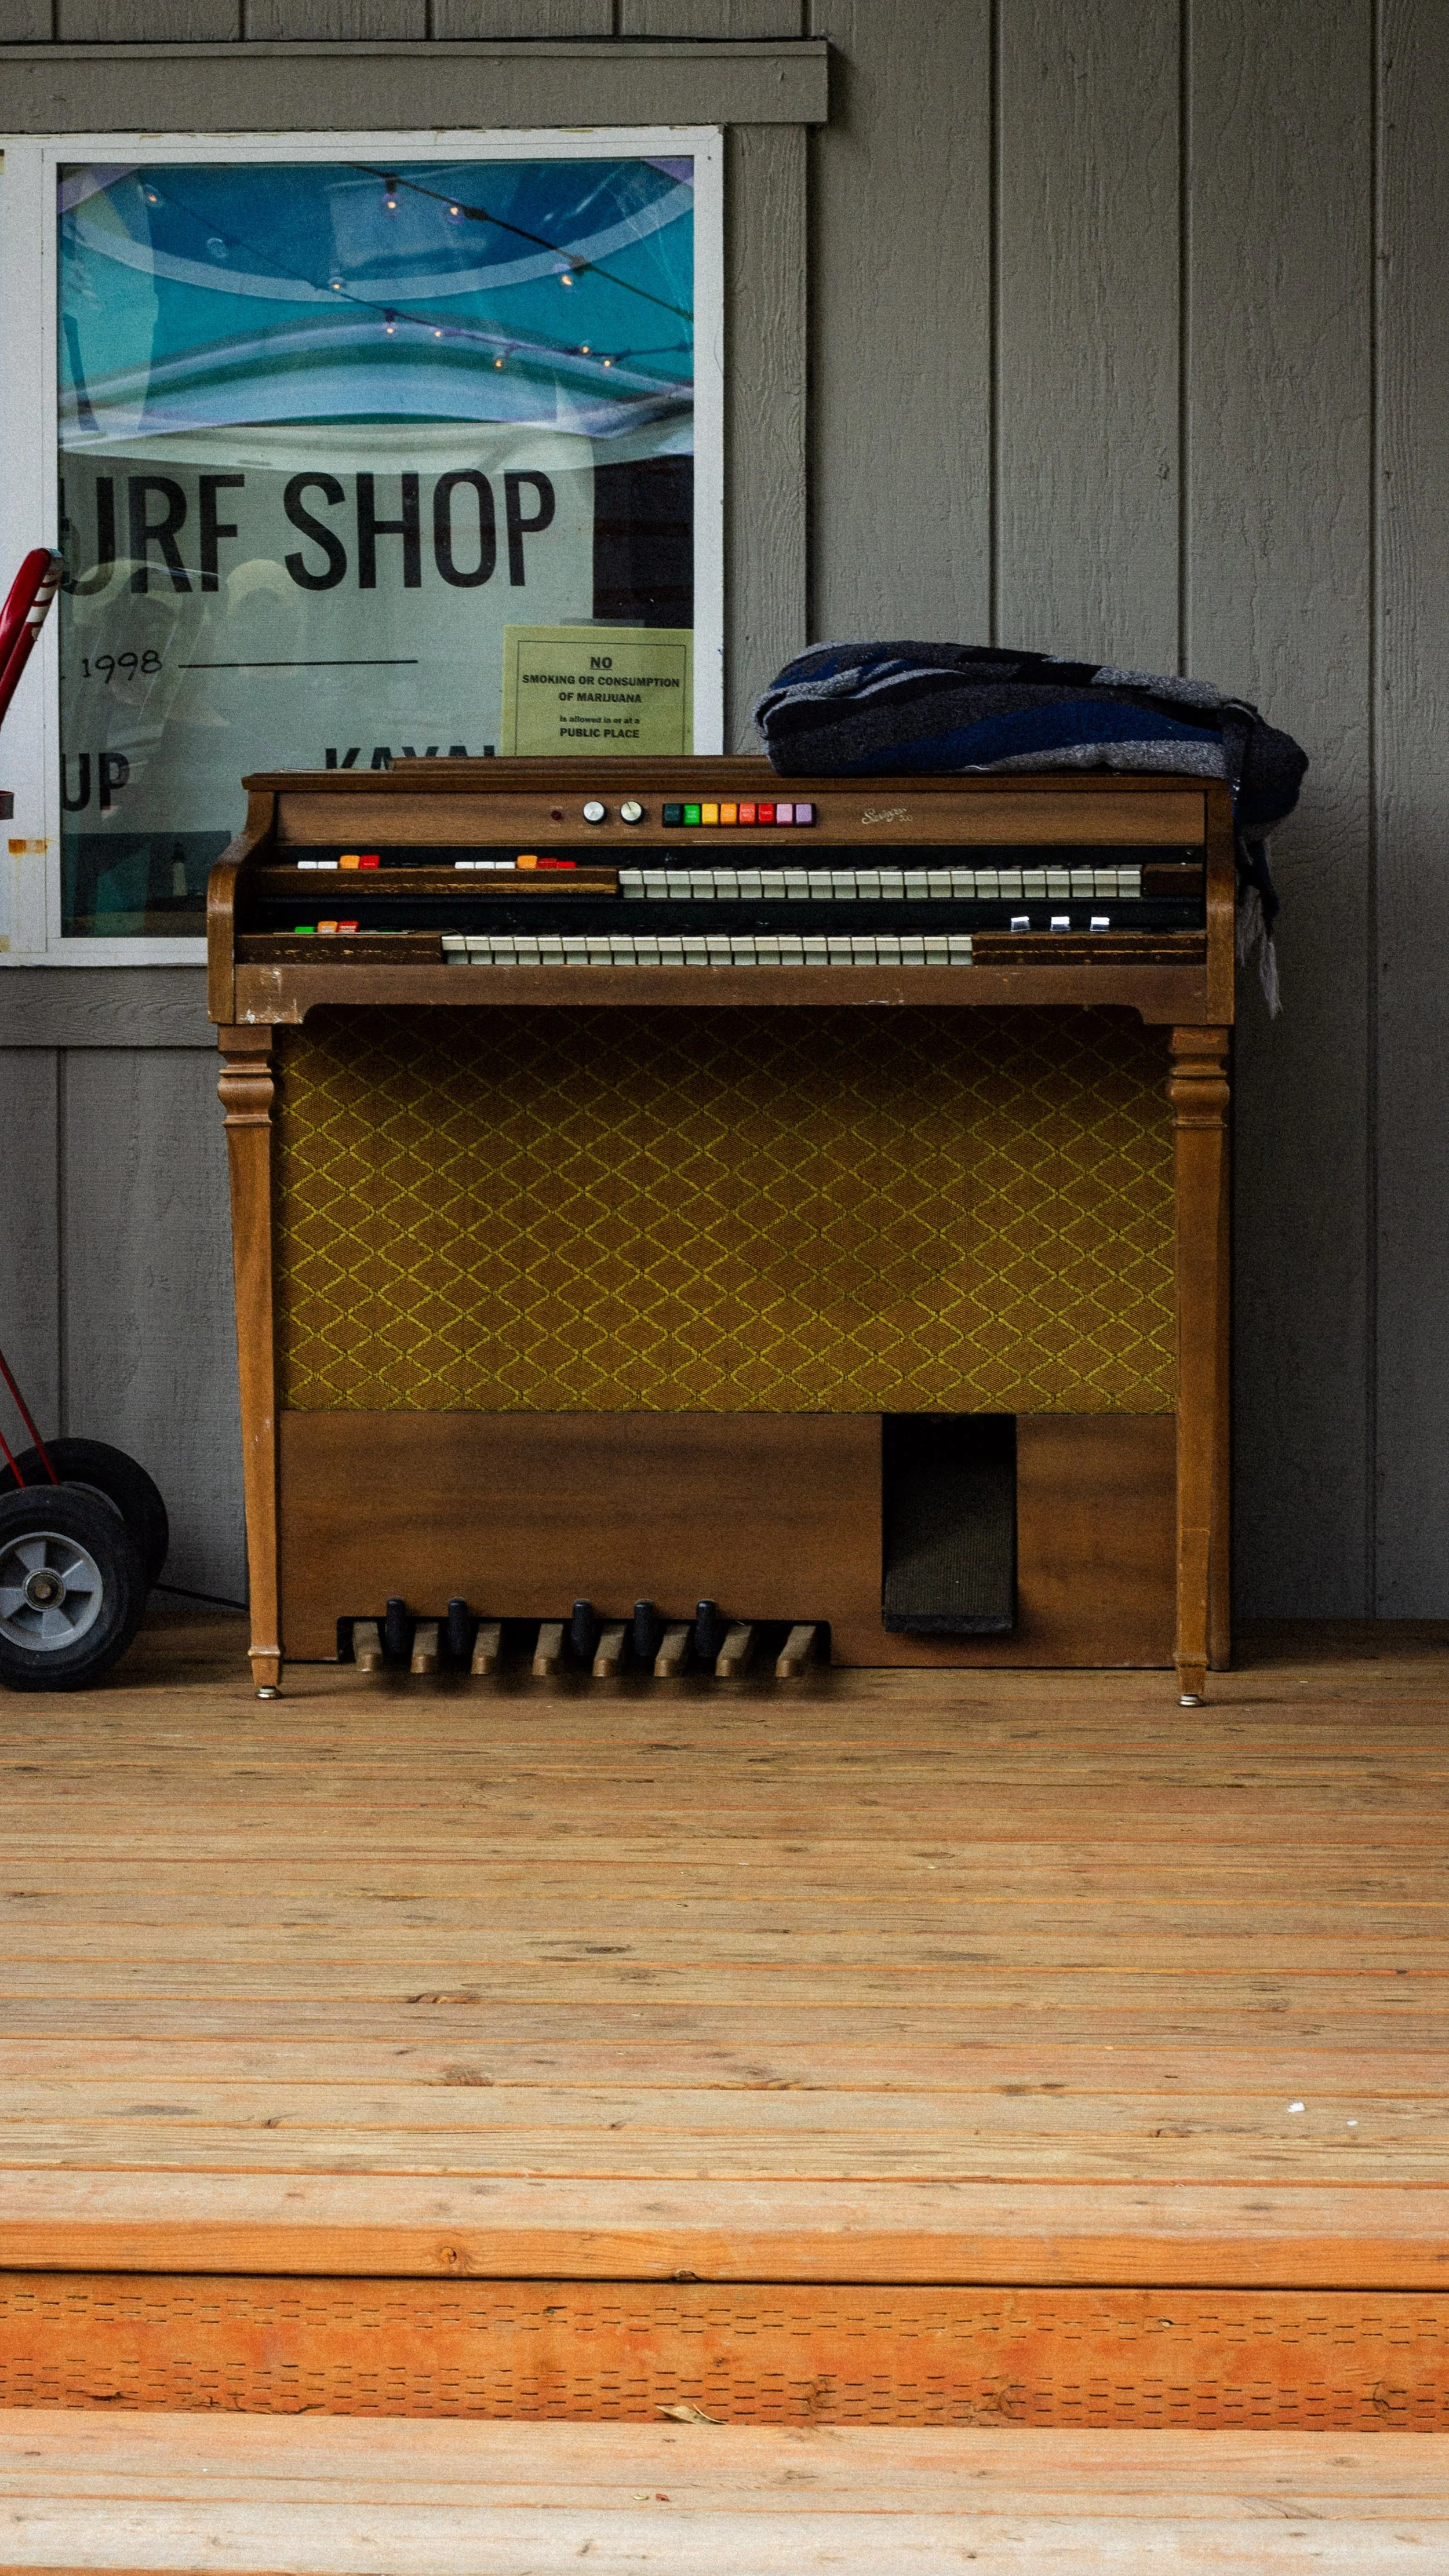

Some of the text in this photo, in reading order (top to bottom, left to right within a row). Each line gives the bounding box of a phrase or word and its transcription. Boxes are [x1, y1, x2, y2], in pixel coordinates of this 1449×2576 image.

[283, 468, 556, 591] SHOP
[82, 650, 162, 684] 1998
[590, 657, 613, 670] NO
[522, 674, 680, 688] SMOKING OR CONSUMPTION
[558, 691, 642, 704] OF MARIJUANA
[569, 716, 602, 724] allowed
[559, 727, 640, 739] PUBLIC PLACE
[60, 752, 130, 812] UP
